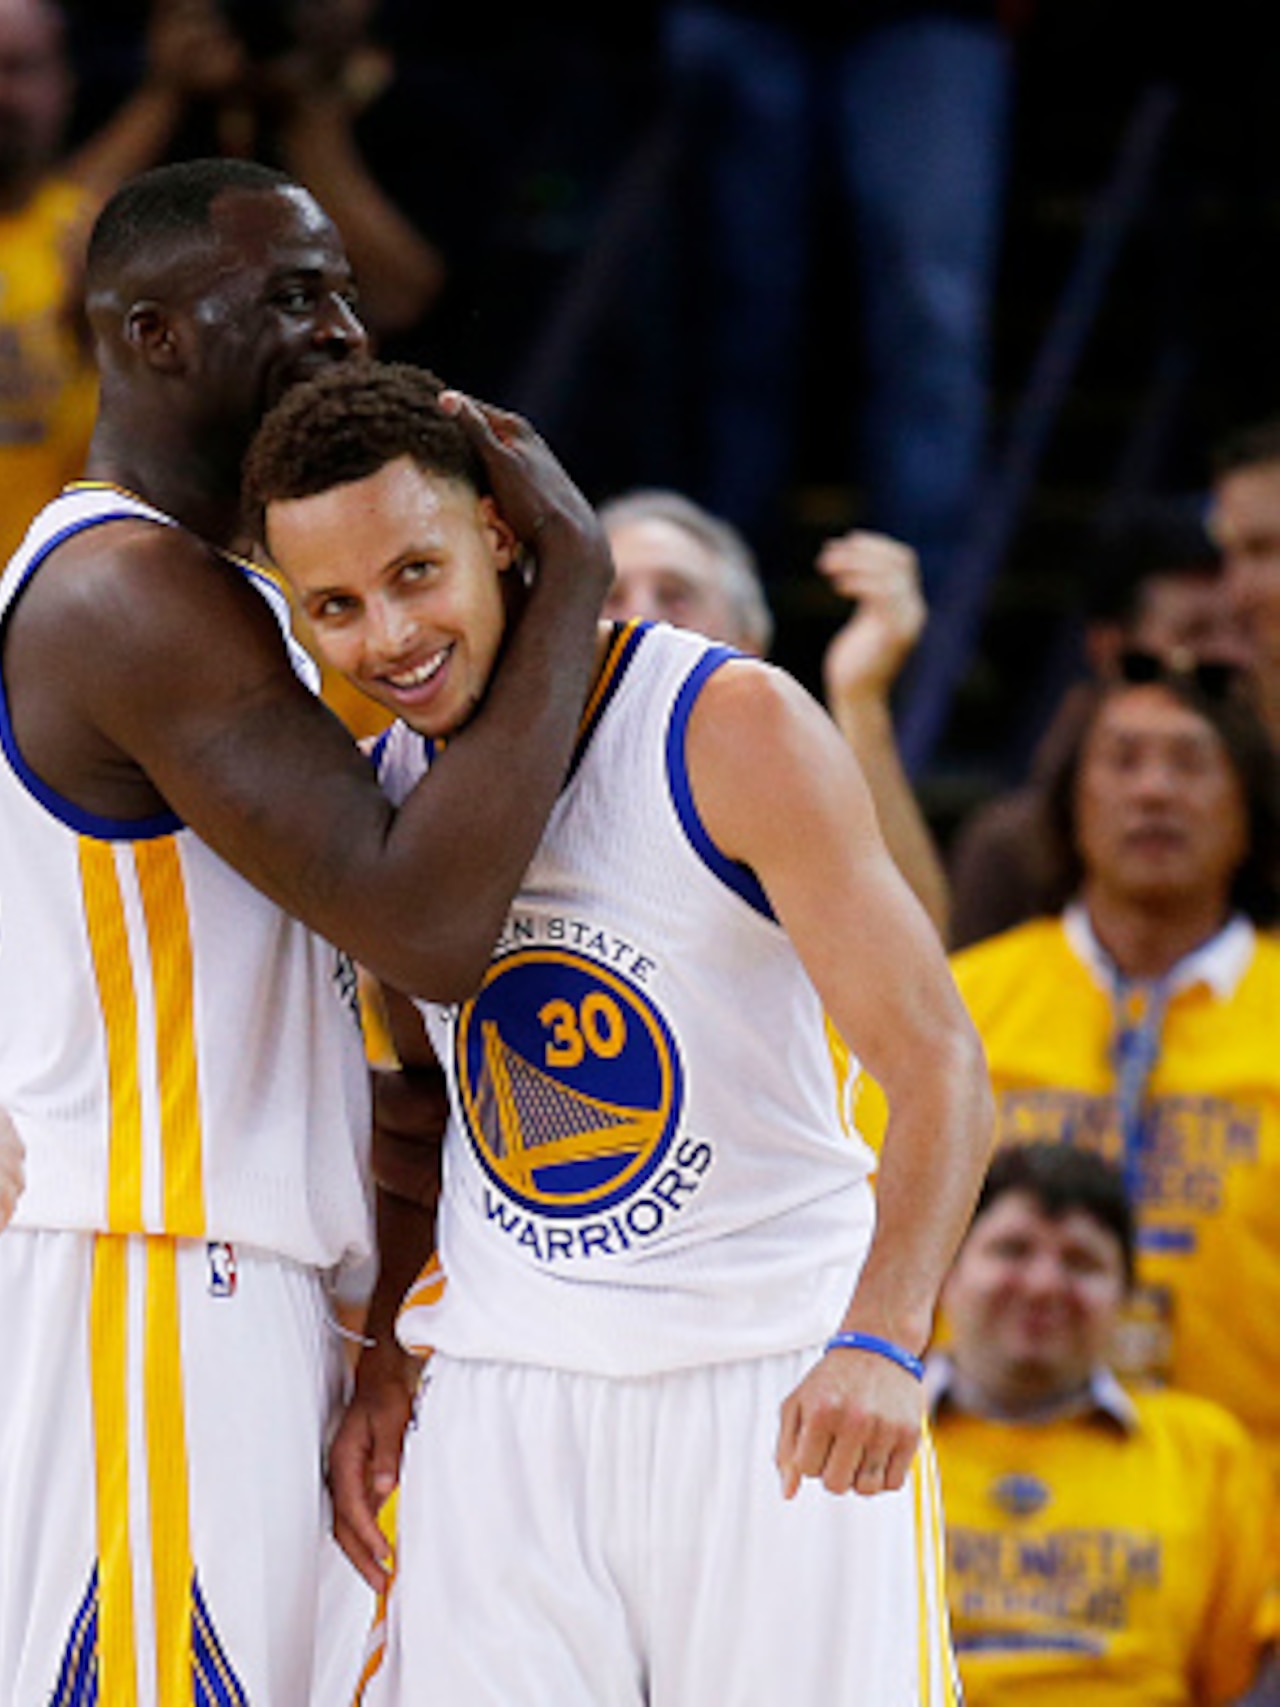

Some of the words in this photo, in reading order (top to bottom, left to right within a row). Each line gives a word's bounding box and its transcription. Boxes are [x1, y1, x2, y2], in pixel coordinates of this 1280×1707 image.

[546, 917, 657, 983] STATE
[537, 991, 627, 1068] 30
[483, 1137, 712, 1262] WARRIORS
